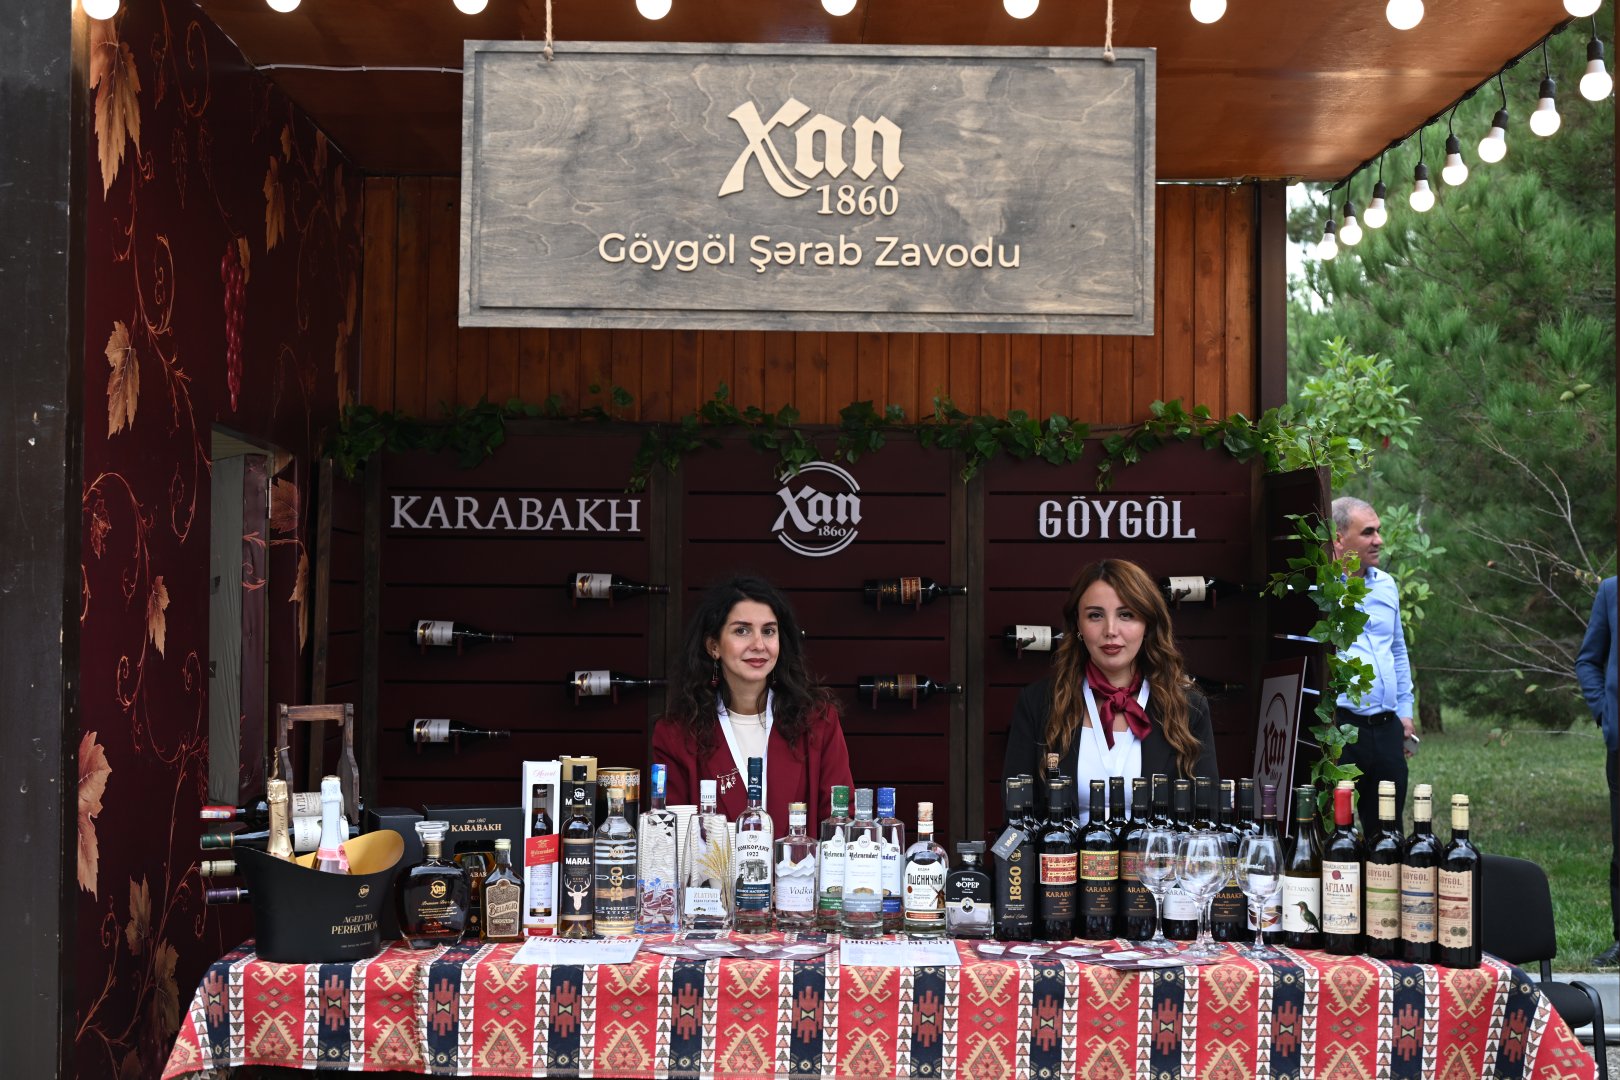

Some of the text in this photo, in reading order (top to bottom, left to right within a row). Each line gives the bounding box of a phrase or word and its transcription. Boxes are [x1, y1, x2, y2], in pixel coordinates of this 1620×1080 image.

[718, 97, 905, 198] Xan
[816, 185, 899, 216] 1860
[598, 232, 1022, 274] Göygöl Şərab Zavodu
[390, 495, 641, 533] KARABAKH
[771, 485, 863, 533] Xan
[1038, 495, 1197, 539] GÖYGÖL
[818, 525, 848, 537] 1860
[451, 823, 502, 832] KARABAKH
[1004, 831, 1018, 848] 1860
[565, 857, 591, 866] MARAL
[789, 886, 813, 895] Vodka
[955, 881, 980, 889] ФОРЕР
[1009, 865, 1022, 902] 1860
[1325, 882, 1354, 893] АГДАМ
[343, 913, 373, 923] AGED TO
[331, 920, 378, 934] PERFECTION
